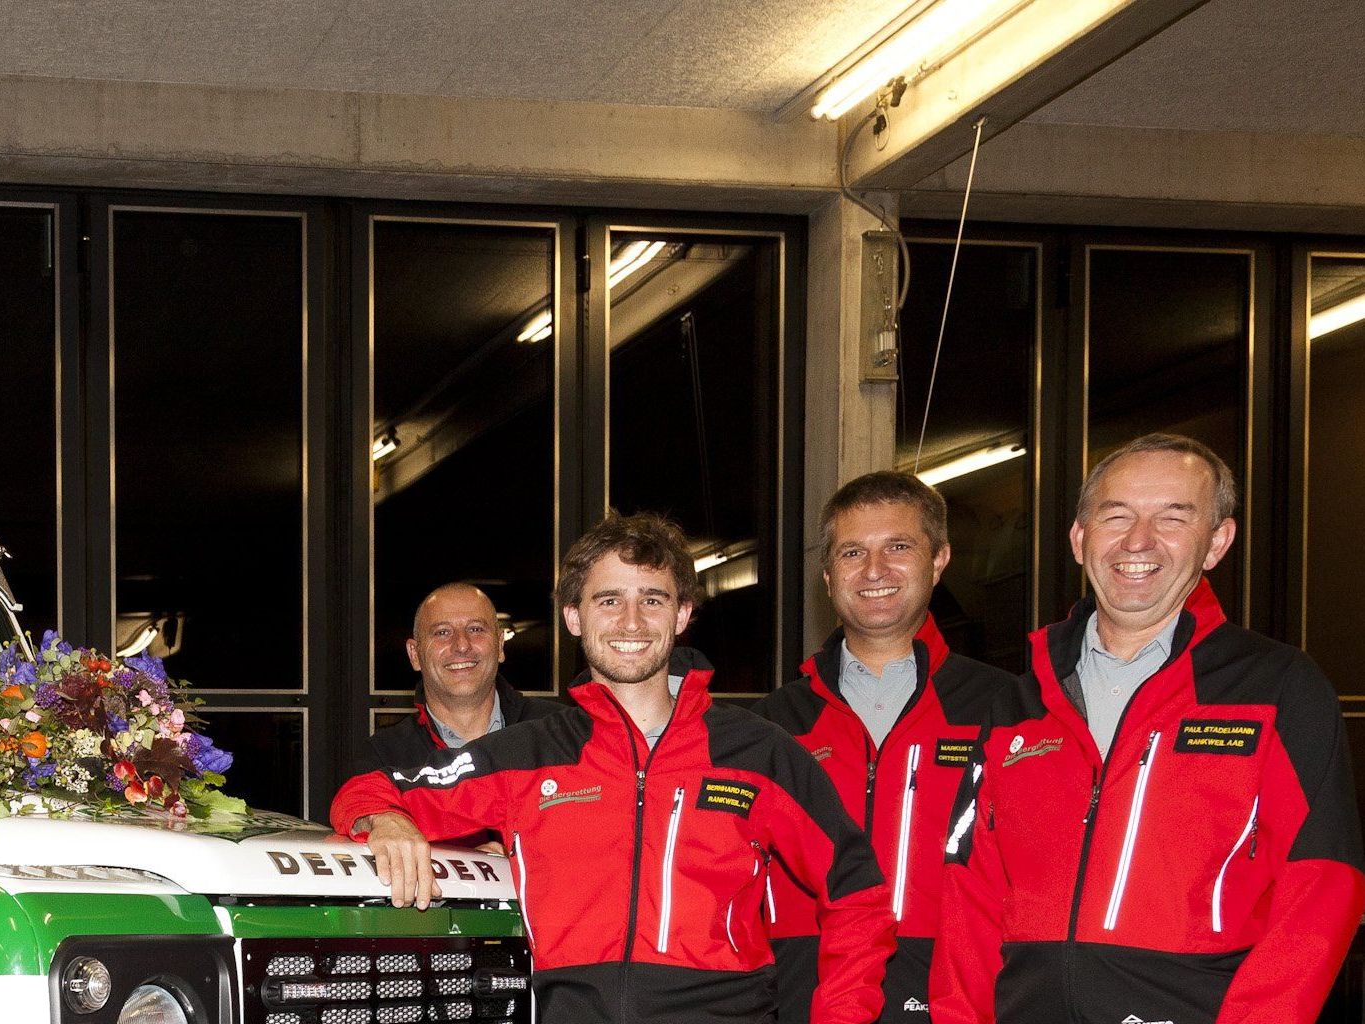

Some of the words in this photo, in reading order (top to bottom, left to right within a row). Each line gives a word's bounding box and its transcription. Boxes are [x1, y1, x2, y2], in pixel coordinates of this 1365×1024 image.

[1203, 726, 1255, 735] STADELMANN
[1187, 739, 1227, 747] RANKWEIL
[552, 785, 602, 799] Bergrettung
[706, 784, 740, 794] BERNHARD
